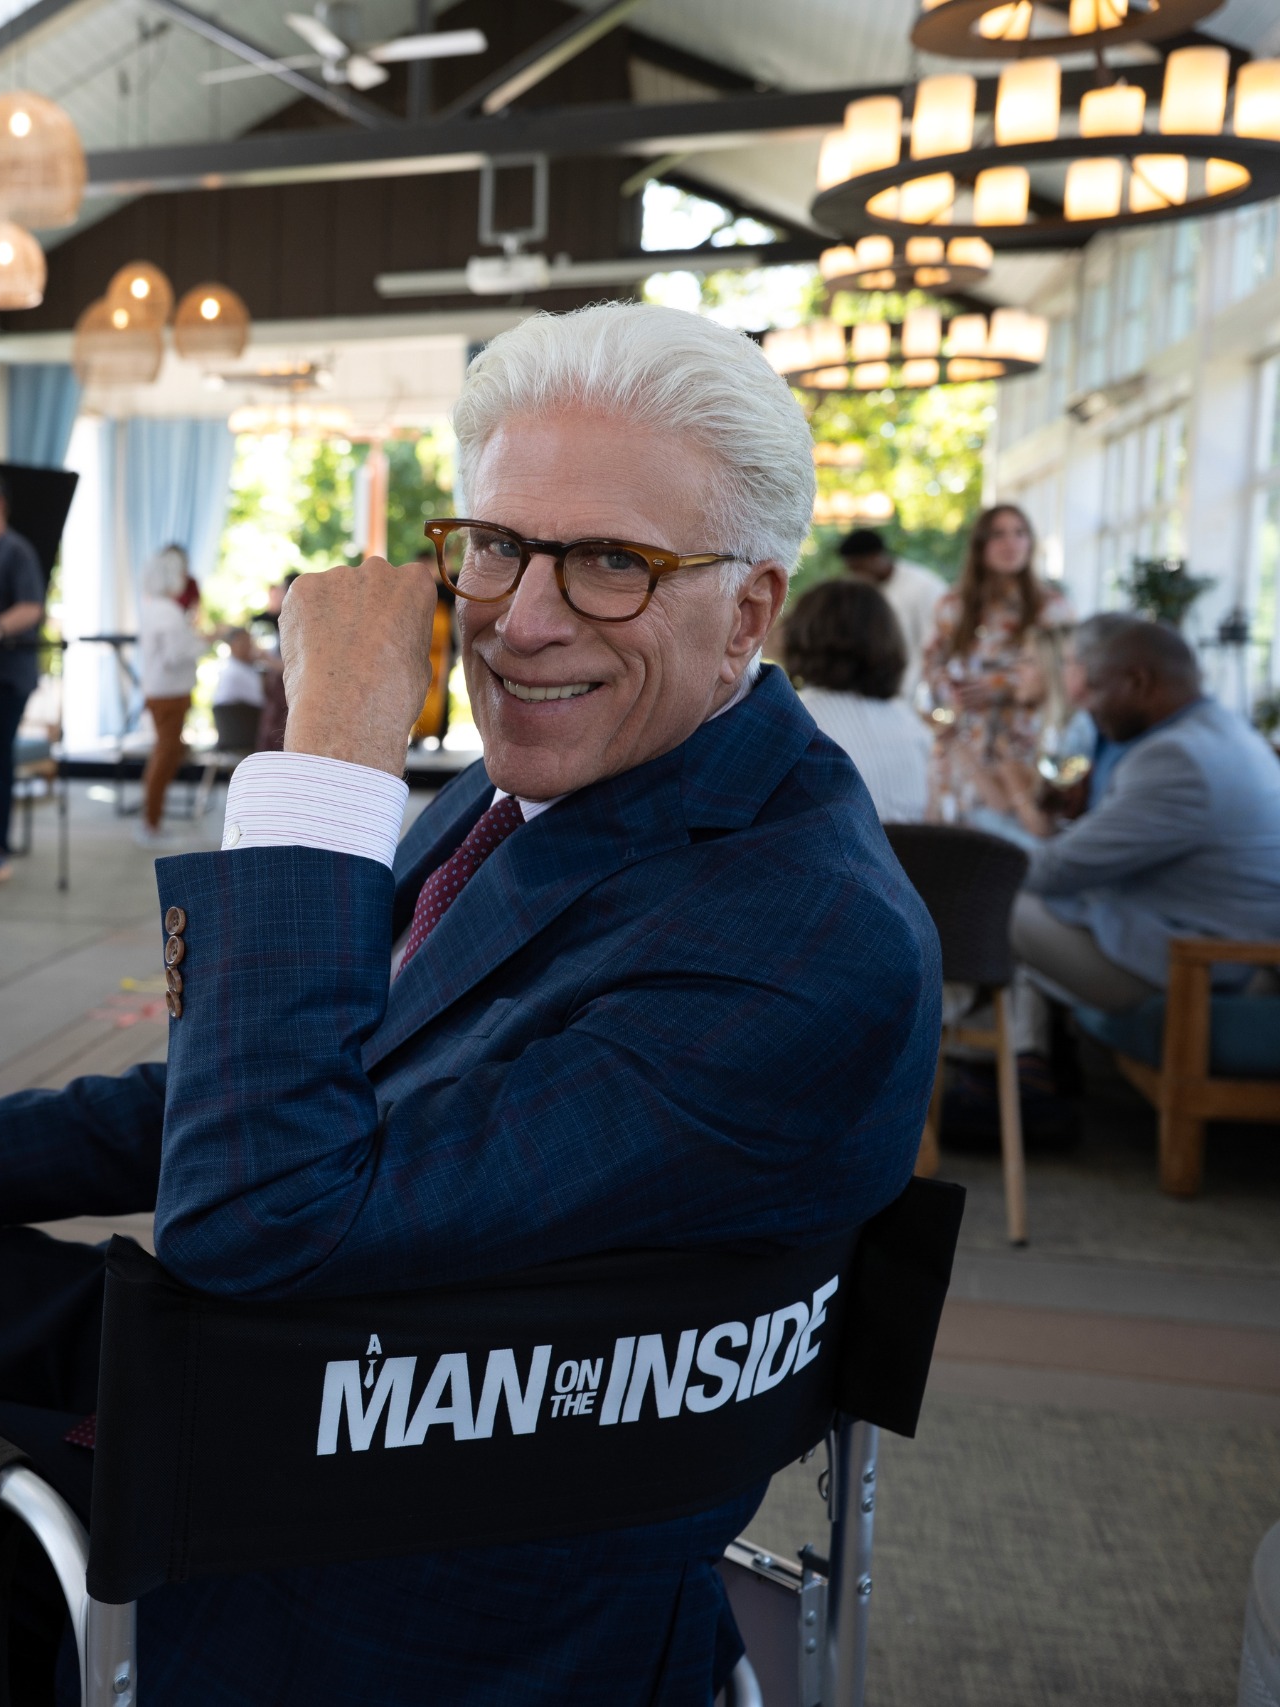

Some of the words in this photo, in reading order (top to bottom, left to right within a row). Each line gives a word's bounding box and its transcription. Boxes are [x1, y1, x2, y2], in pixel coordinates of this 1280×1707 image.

[366, 1333, 382, 1355] A
[598, 1274, 839, 1427] INSIDE
[554, 1357, 604, 1394] ON
[316, 1344, 552, 1456] MAN
[550, 1391, 599, 1418] THE
